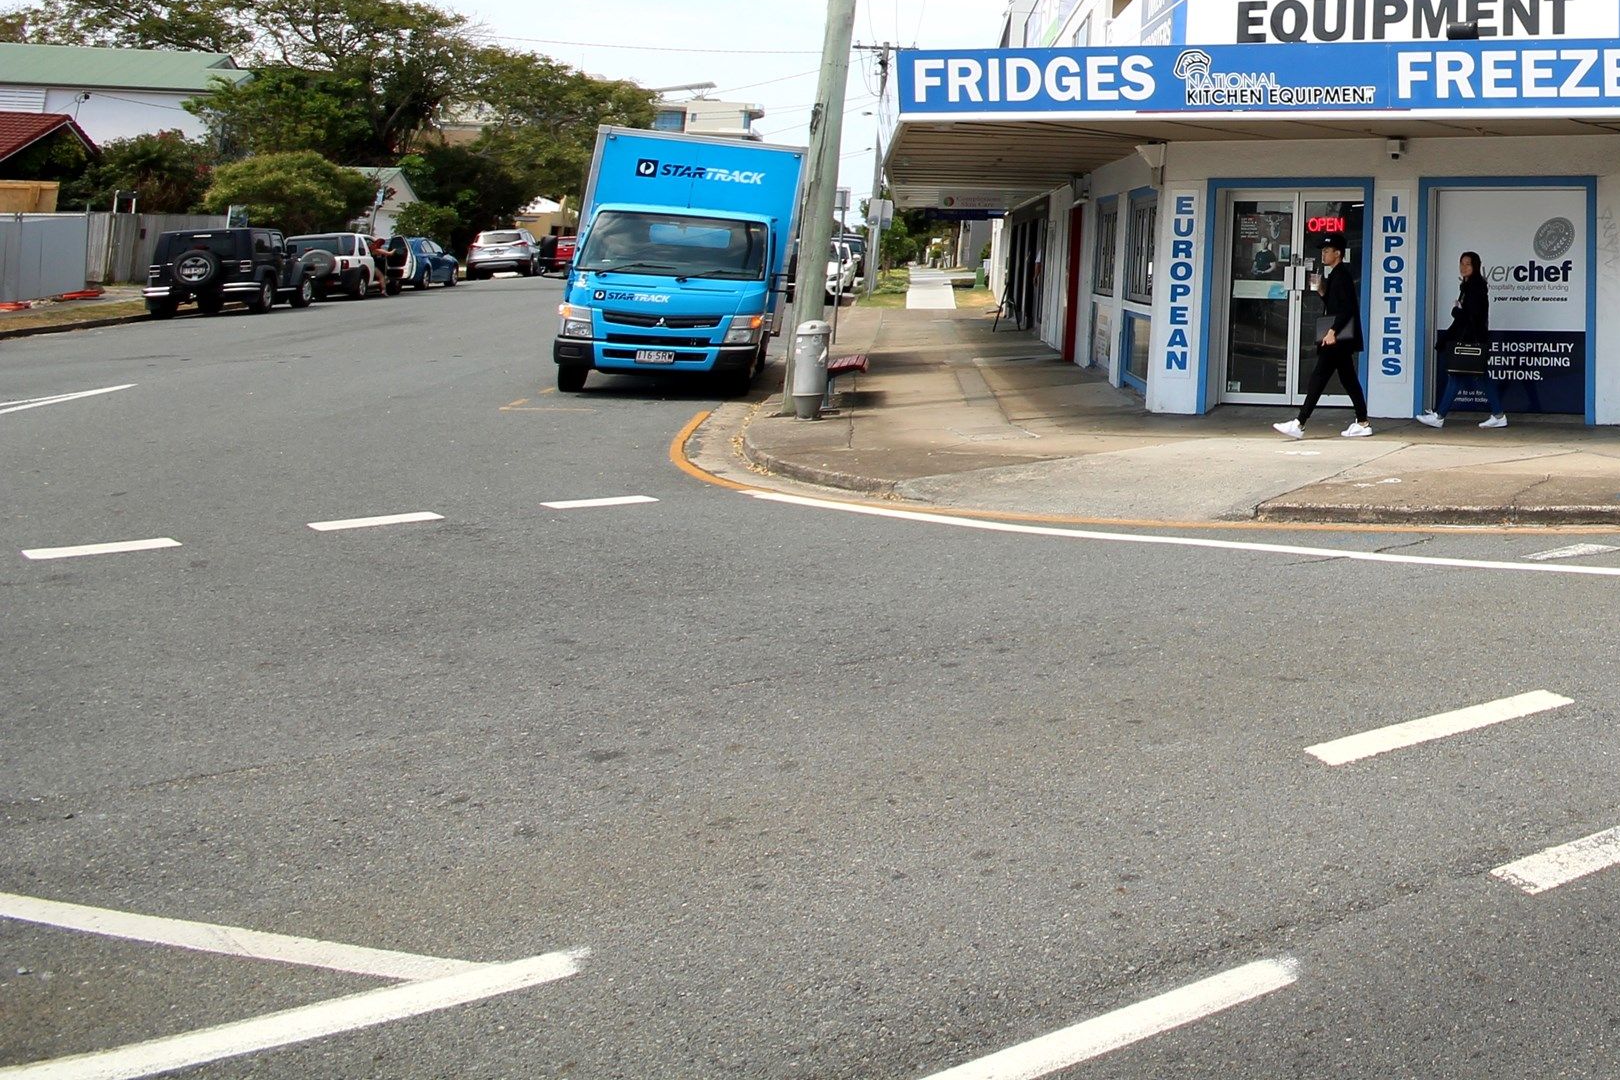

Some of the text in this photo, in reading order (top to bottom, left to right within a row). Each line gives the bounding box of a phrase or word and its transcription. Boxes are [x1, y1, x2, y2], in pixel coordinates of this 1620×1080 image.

[913, 56, 1155, 103] FRIDGES
[1187, 72, 1280, 90] NATIONAL
[1186, 86, 1376, 106] KITCHEN EQUIPMENT
[660, 163, 766, 185] STARTRACK
[1308, 217, 1345, 232] OPEN
[1471, 260, 1573, 283] verchef
[1166, 196, 1195, 371] EUROPEAN
[1381, 195, 1407, 376] IMPORTERS
[1516, 283, 1546, 292] equipment
[1547, 283, 1569, 293] funding
[607, 292, 671, 303] STARTRACK
[1509, 295, 1530, 303] recipe
[1531, 295, 1541, 303] for
[1502, 341, 1575, 353] HOSPITALITY
[1519, 356, 1571, 367] FUNDING
